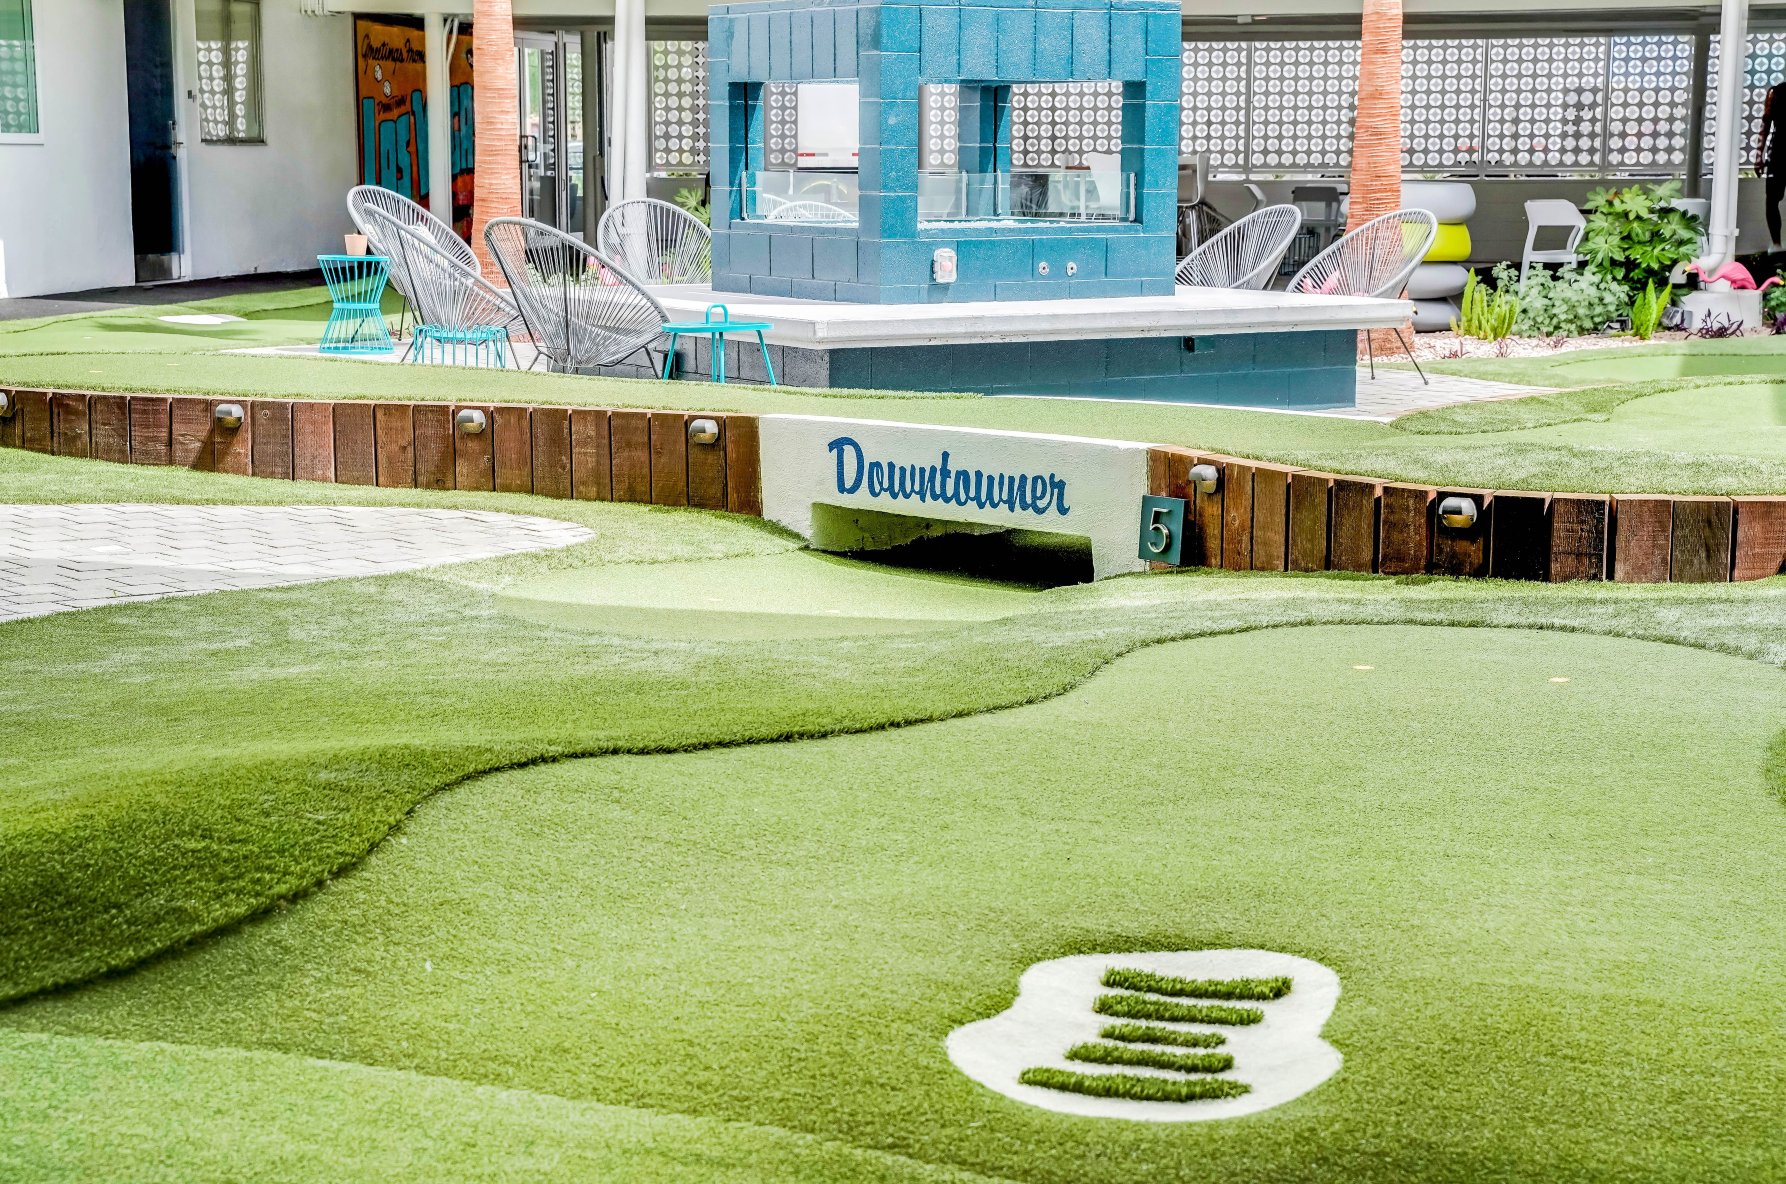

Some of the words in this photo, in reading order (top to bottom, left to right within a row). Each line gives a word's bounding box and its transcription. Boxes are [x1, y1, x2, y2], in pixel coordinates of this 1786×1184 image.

[361, 33, 404, 75] Greetings
[828, 436, 1071, 516] Downtowner
[1147, 507, 1171, 554] 5
